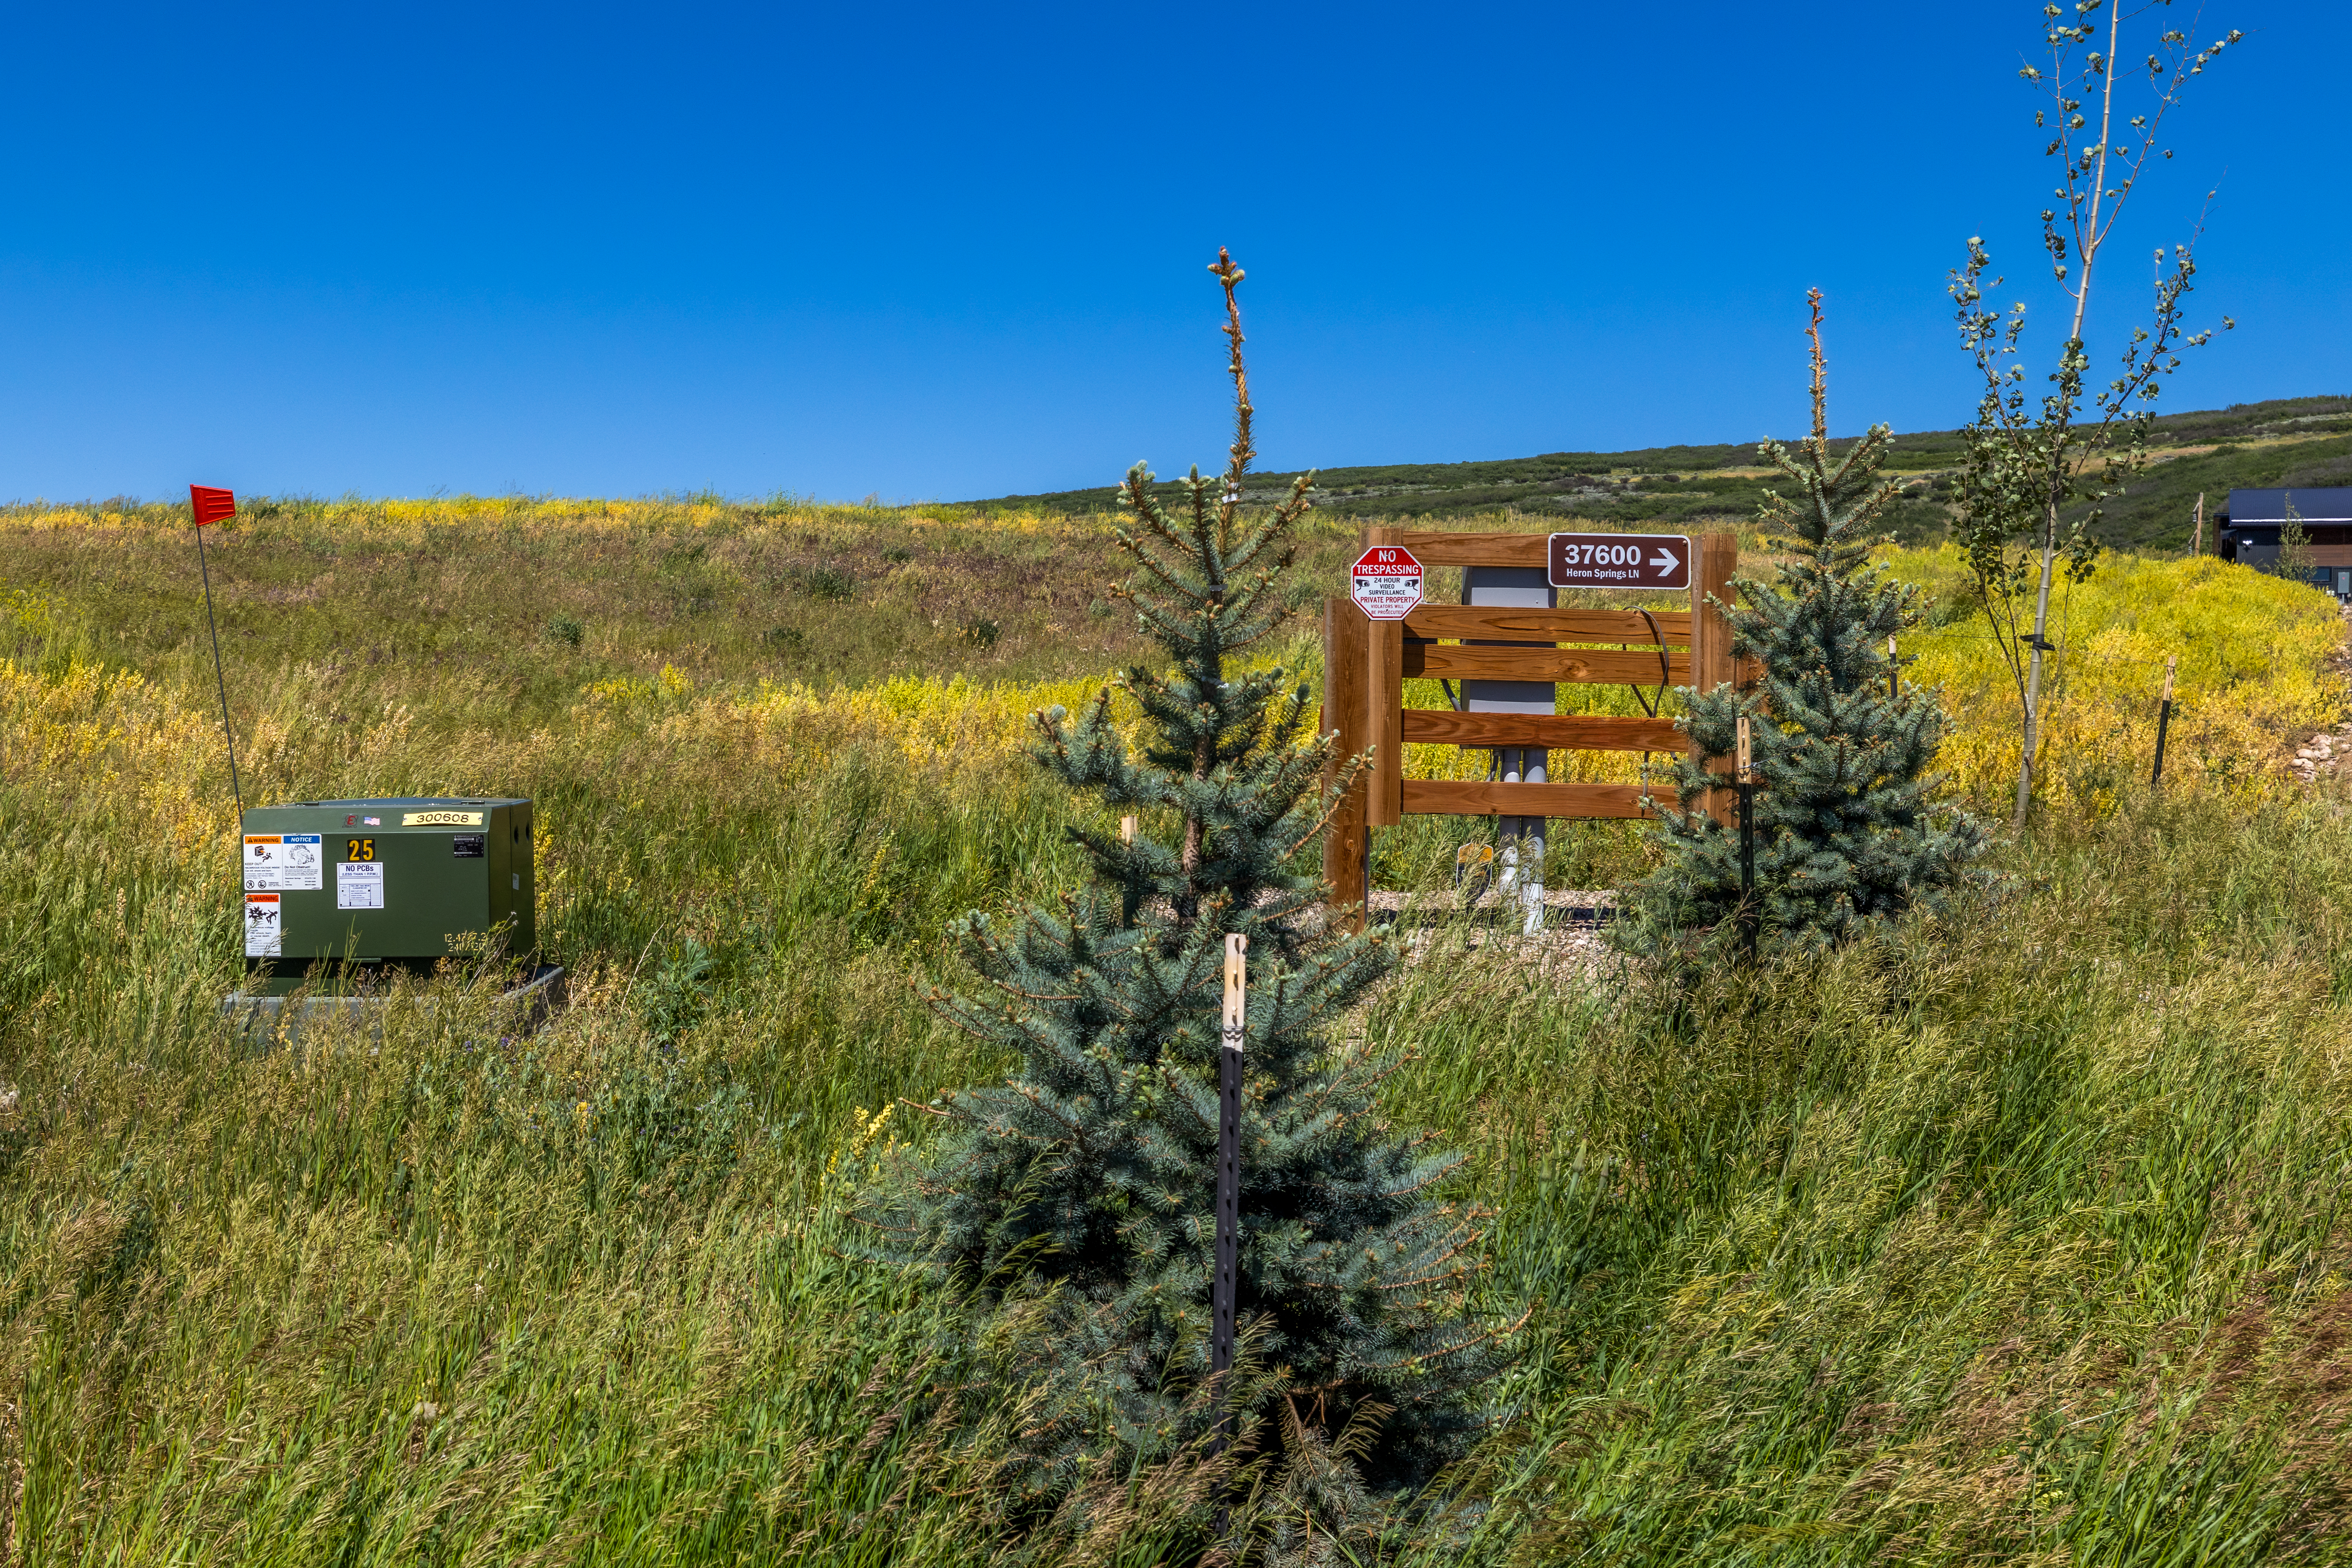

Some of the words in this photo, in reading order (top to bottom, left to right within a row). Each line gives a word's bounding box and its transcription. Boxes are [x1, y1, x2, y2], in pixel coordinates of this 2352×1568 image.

[1379, 550, 1396, 562] NO
[1565, 544, 1641, 565] 37600
[1356, 565, 1419, 574] TRESPASSING
[1567, 569, 1592, 577] Heron
[1594, 569, 1626, 580] Springs
[1629, 570, 1639, 578] LN
[417, 813, 469, 823] 300608
[349, 840, 373, 861] 25
